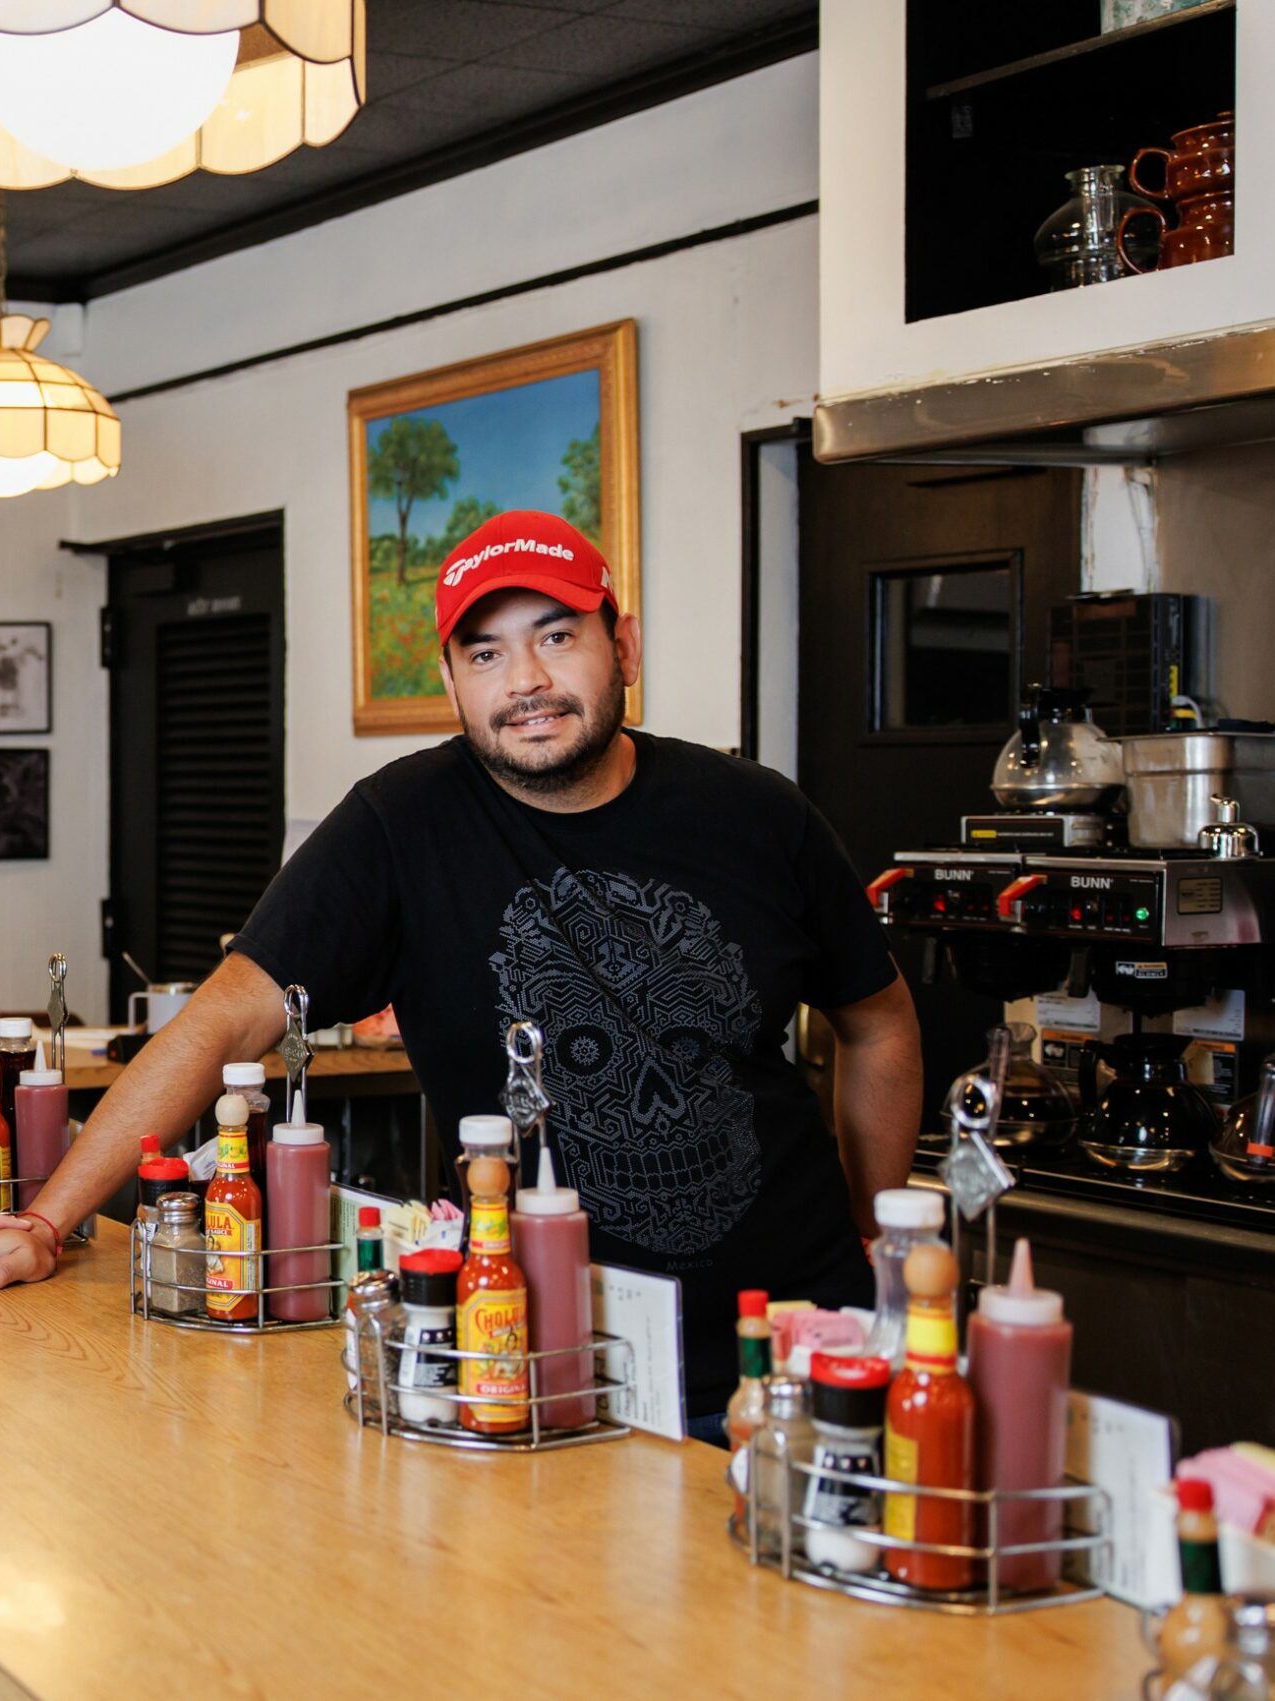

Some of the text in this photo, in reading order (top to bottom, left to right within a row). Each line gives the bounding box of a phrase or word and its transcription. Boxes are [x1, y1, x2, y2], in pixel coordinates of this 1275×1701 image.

[442, 538, 575, 587] TaylorMade
[934, 868, 972, 881] BUNN
[1070, 876, 1111, 889] BUNN
[205, 1216, 231, 1229] LULA
